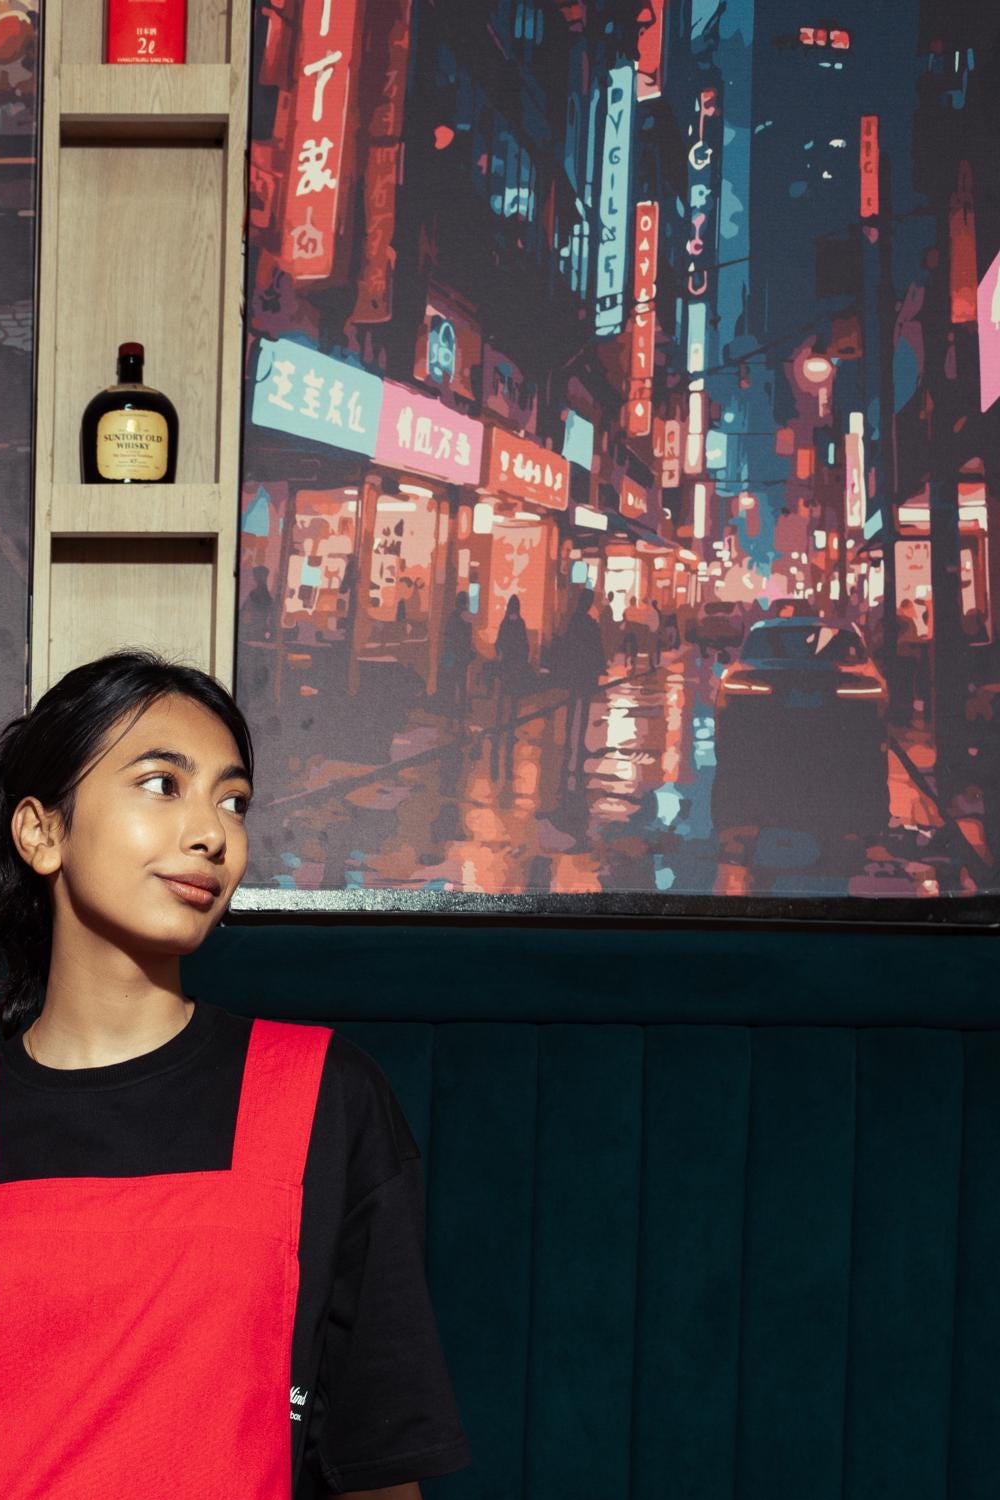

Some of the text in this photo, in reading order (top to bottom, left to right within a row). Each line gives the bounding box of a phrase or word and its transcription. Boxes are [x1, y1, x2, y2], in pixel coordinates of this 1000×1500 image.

[103, 433, 163, 443] SUNTORY OLD
[116, 442, 149, 450] WHISKY
